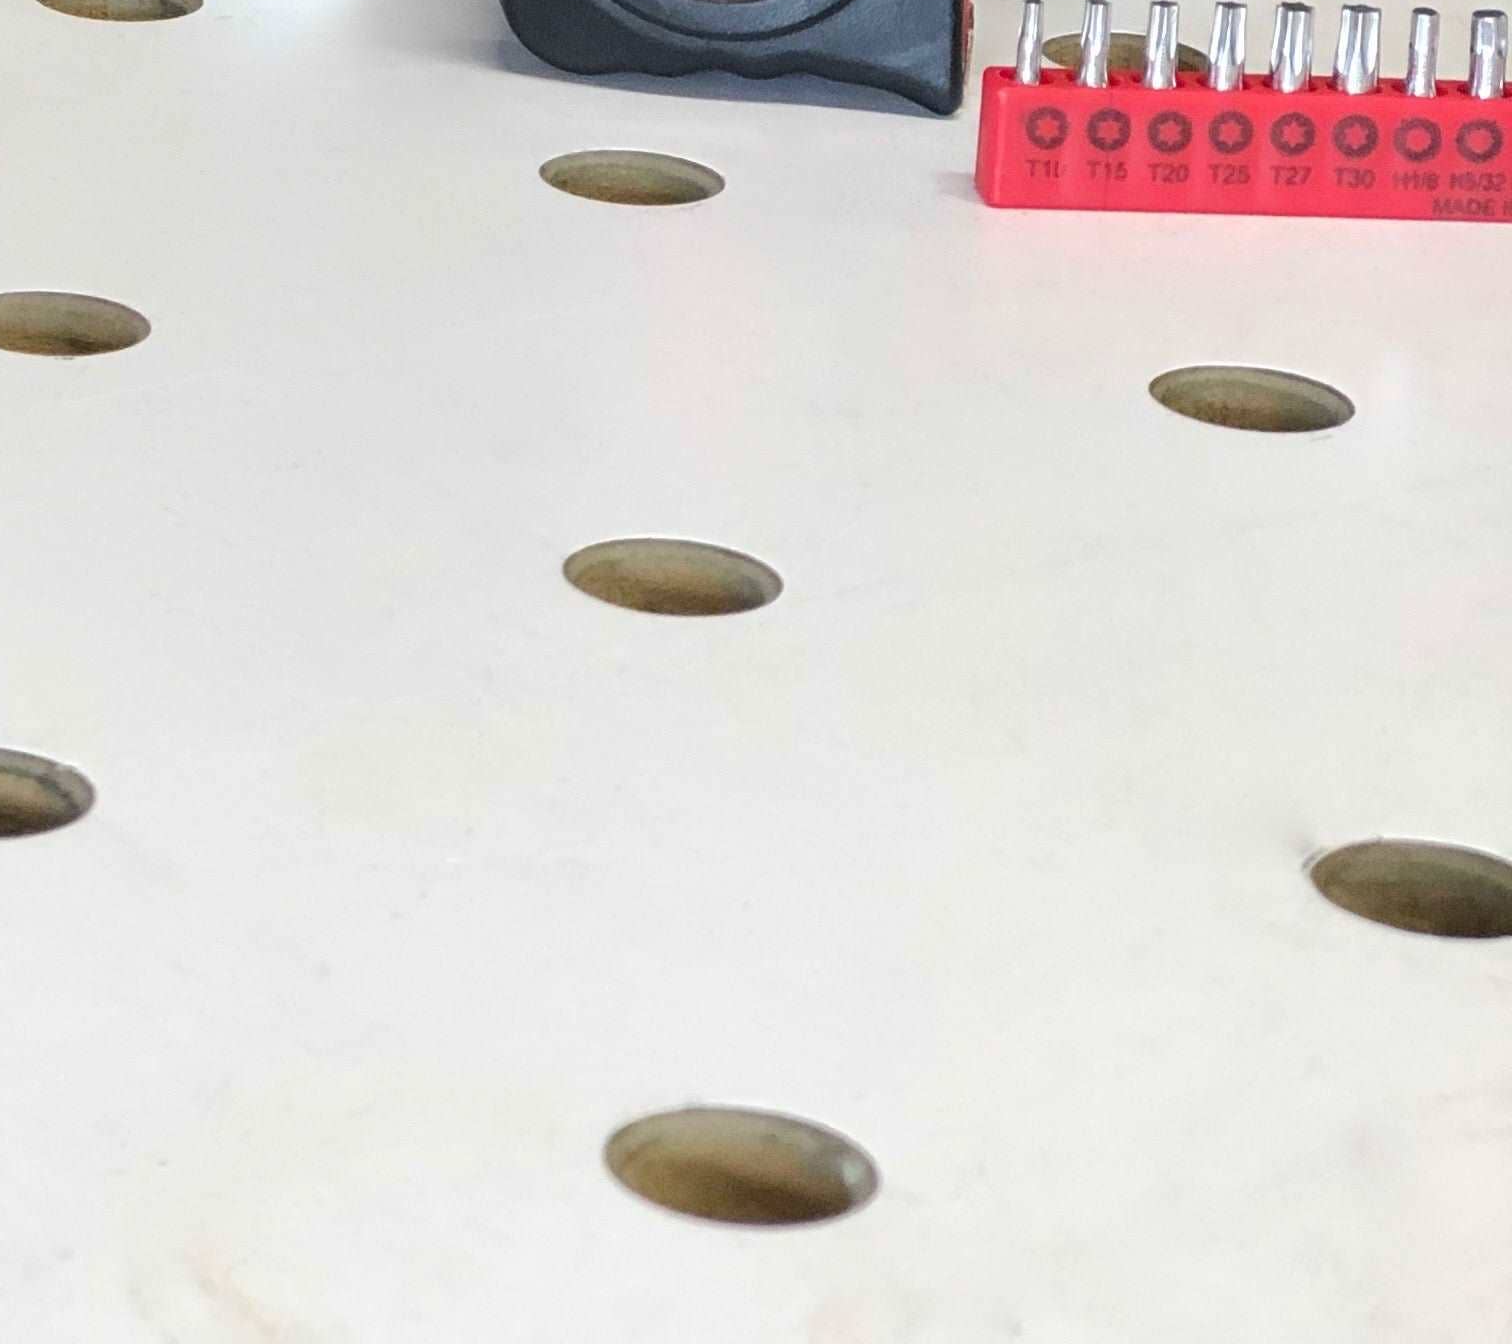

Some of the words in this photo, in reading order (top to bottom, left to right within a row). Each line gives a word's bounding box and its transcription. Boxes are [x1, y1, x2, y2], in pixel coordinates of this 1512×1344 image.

[1147, 163, 1191, 184] T20
[1270, 165, 1313, 185] T27
[1335, 166, 1377, 189] T30
